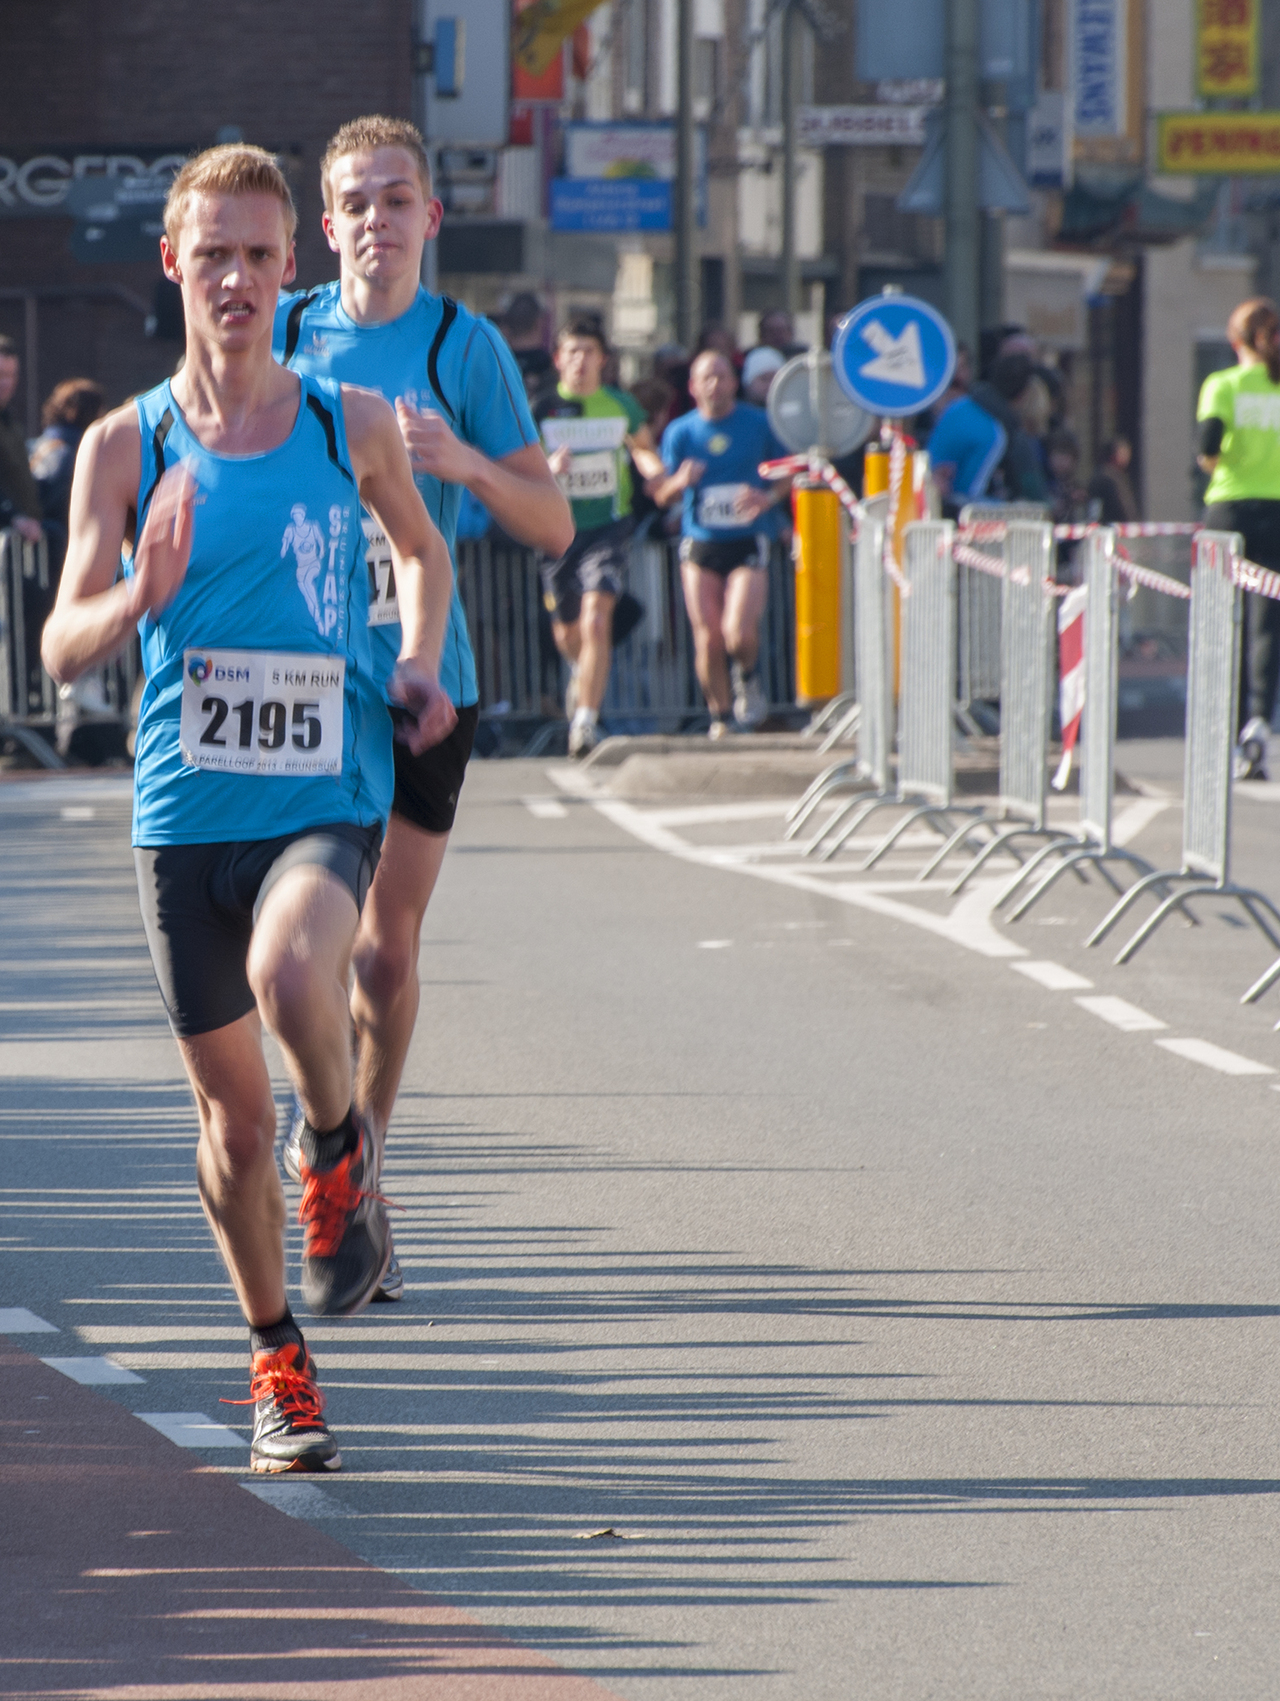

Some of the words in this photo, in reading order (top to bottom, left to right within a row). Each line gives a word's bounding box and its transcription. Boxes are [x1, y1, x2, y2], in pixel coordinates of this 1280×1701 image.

[323, 504, 342, 637] STAP
[215, 667, 250, 683] DSM
[285, 670, 306, 686] KM
[310, 671, 340, 688] RUN
[199, 697, 322, 751] 2195
